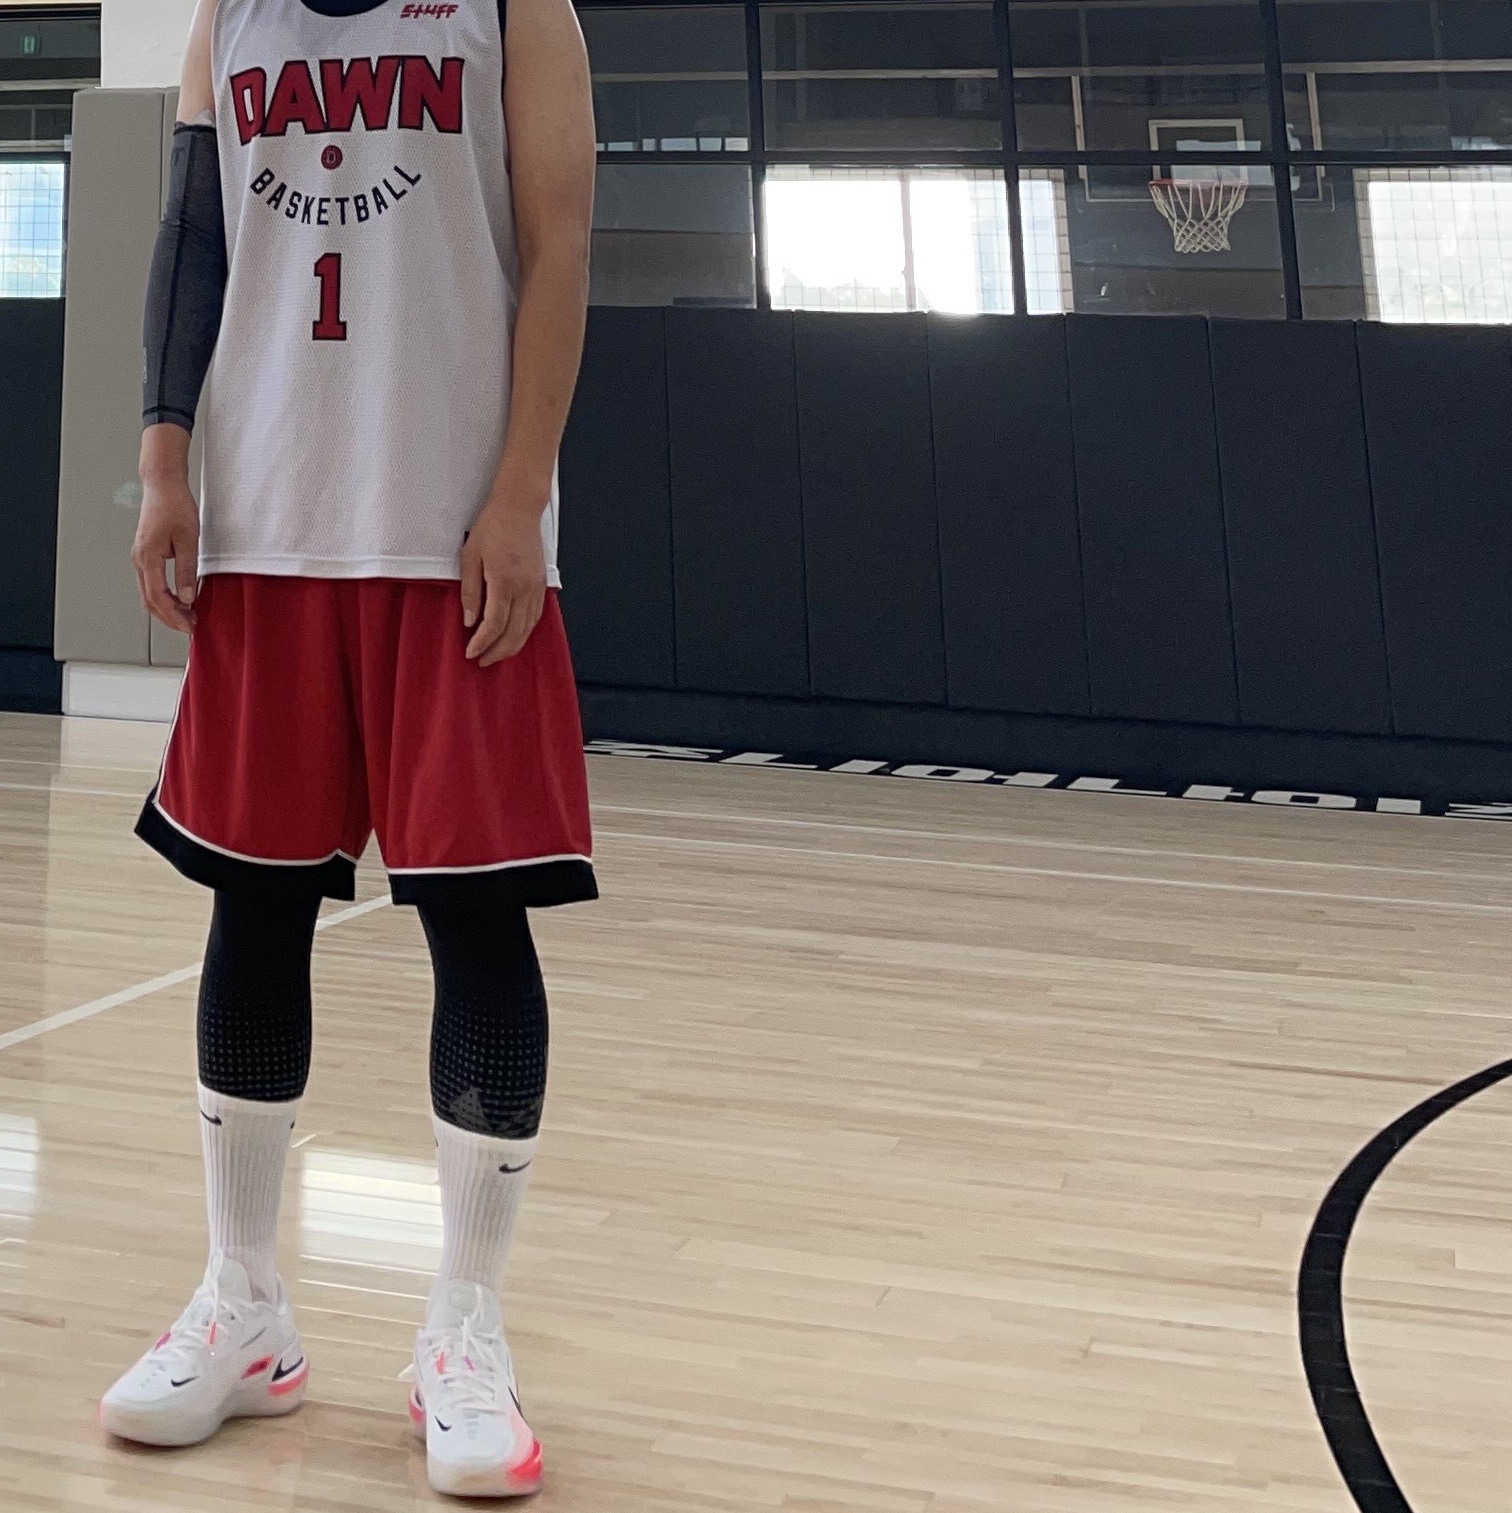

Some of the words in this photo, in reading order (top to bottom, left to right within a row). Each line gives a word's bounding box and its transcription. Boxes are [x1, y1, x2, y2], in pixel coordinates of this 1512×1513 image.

[230, 55, 465, 146] DAWN
[250, 165, 421, 226] BASKETBALL
[312, 252, 347, 341] 1
